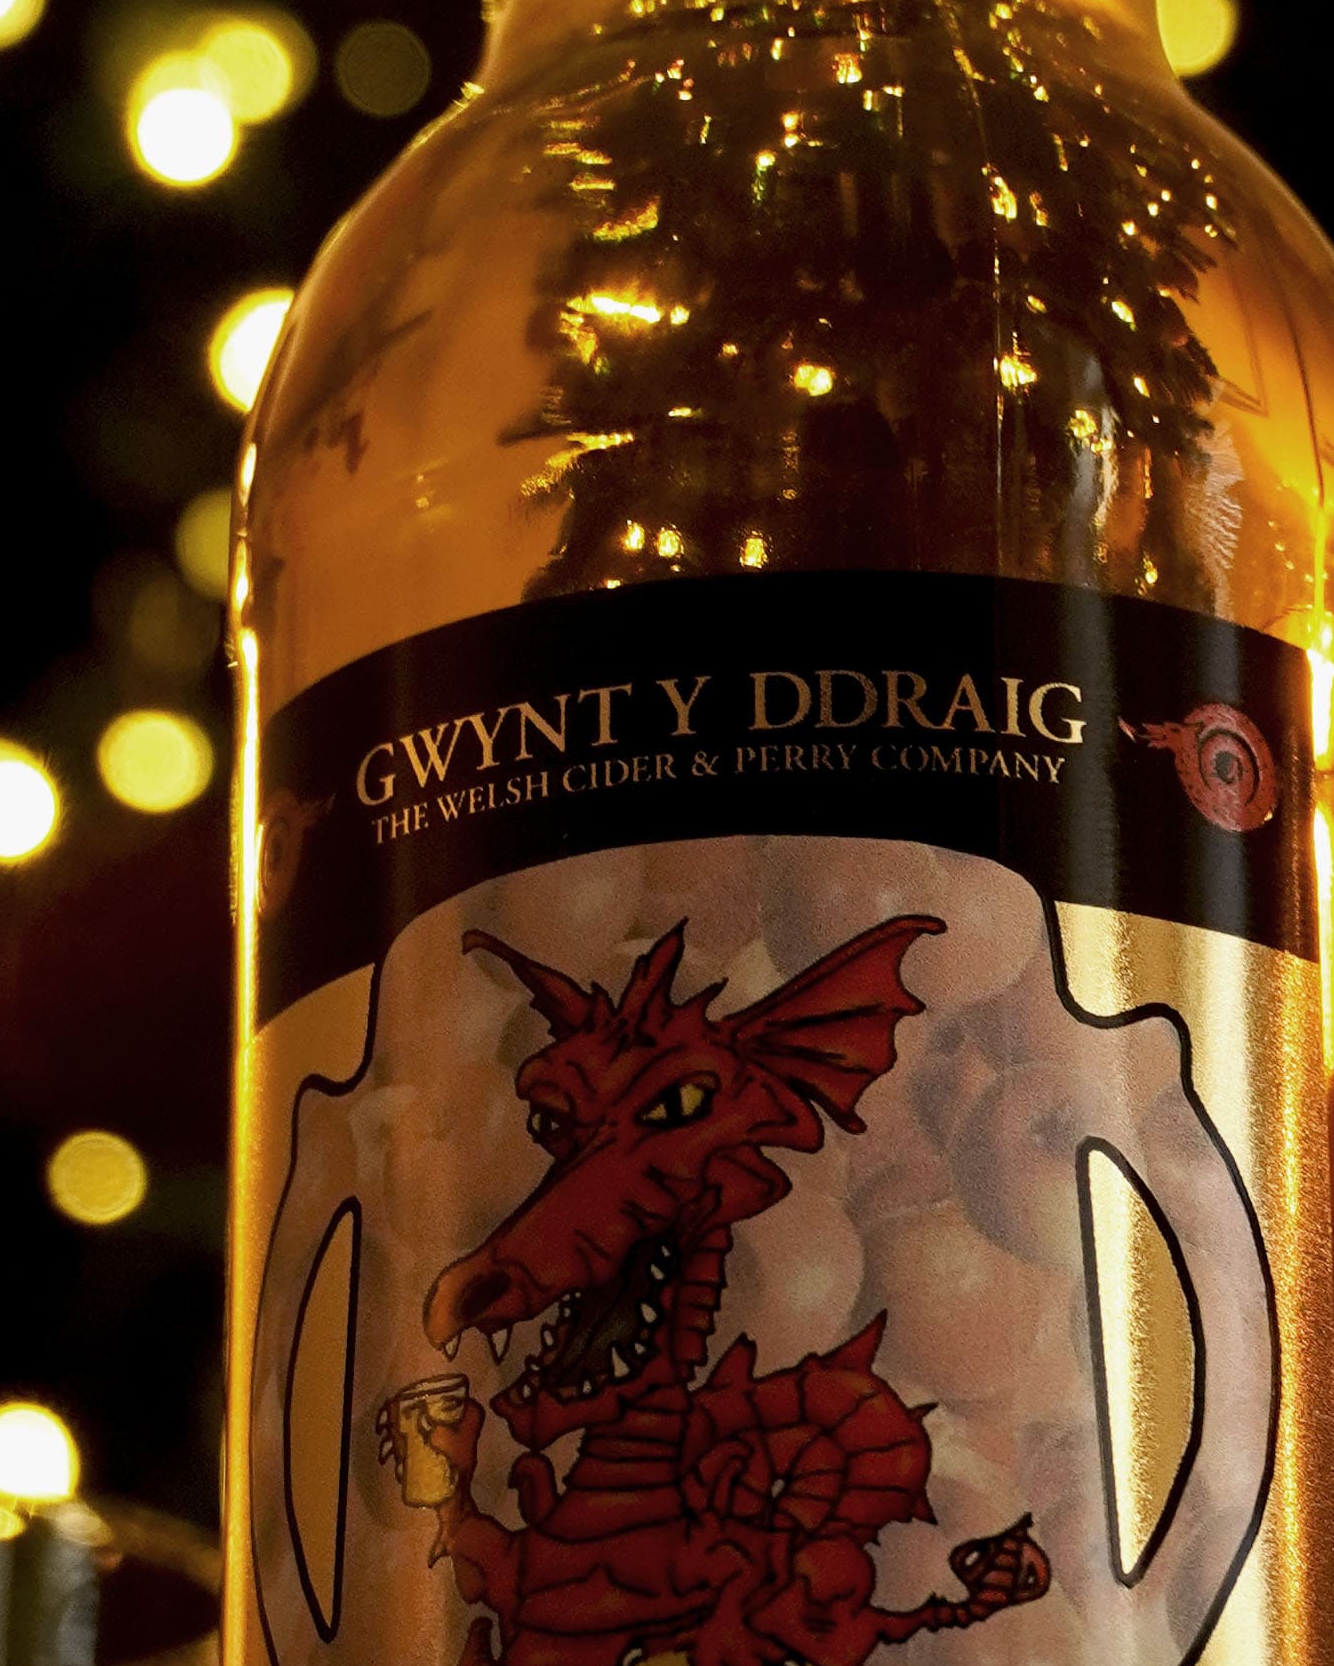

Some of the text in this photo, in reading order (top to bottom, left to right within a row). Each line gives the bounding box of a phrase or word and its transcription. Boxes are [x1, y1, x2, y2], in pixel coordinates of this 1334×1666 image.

[357, 668, 1087, 808] GWYNT Y DDRAIG
[371, 743, 1067, 845] THE WELSH CIDER & PERRY COMPANY
